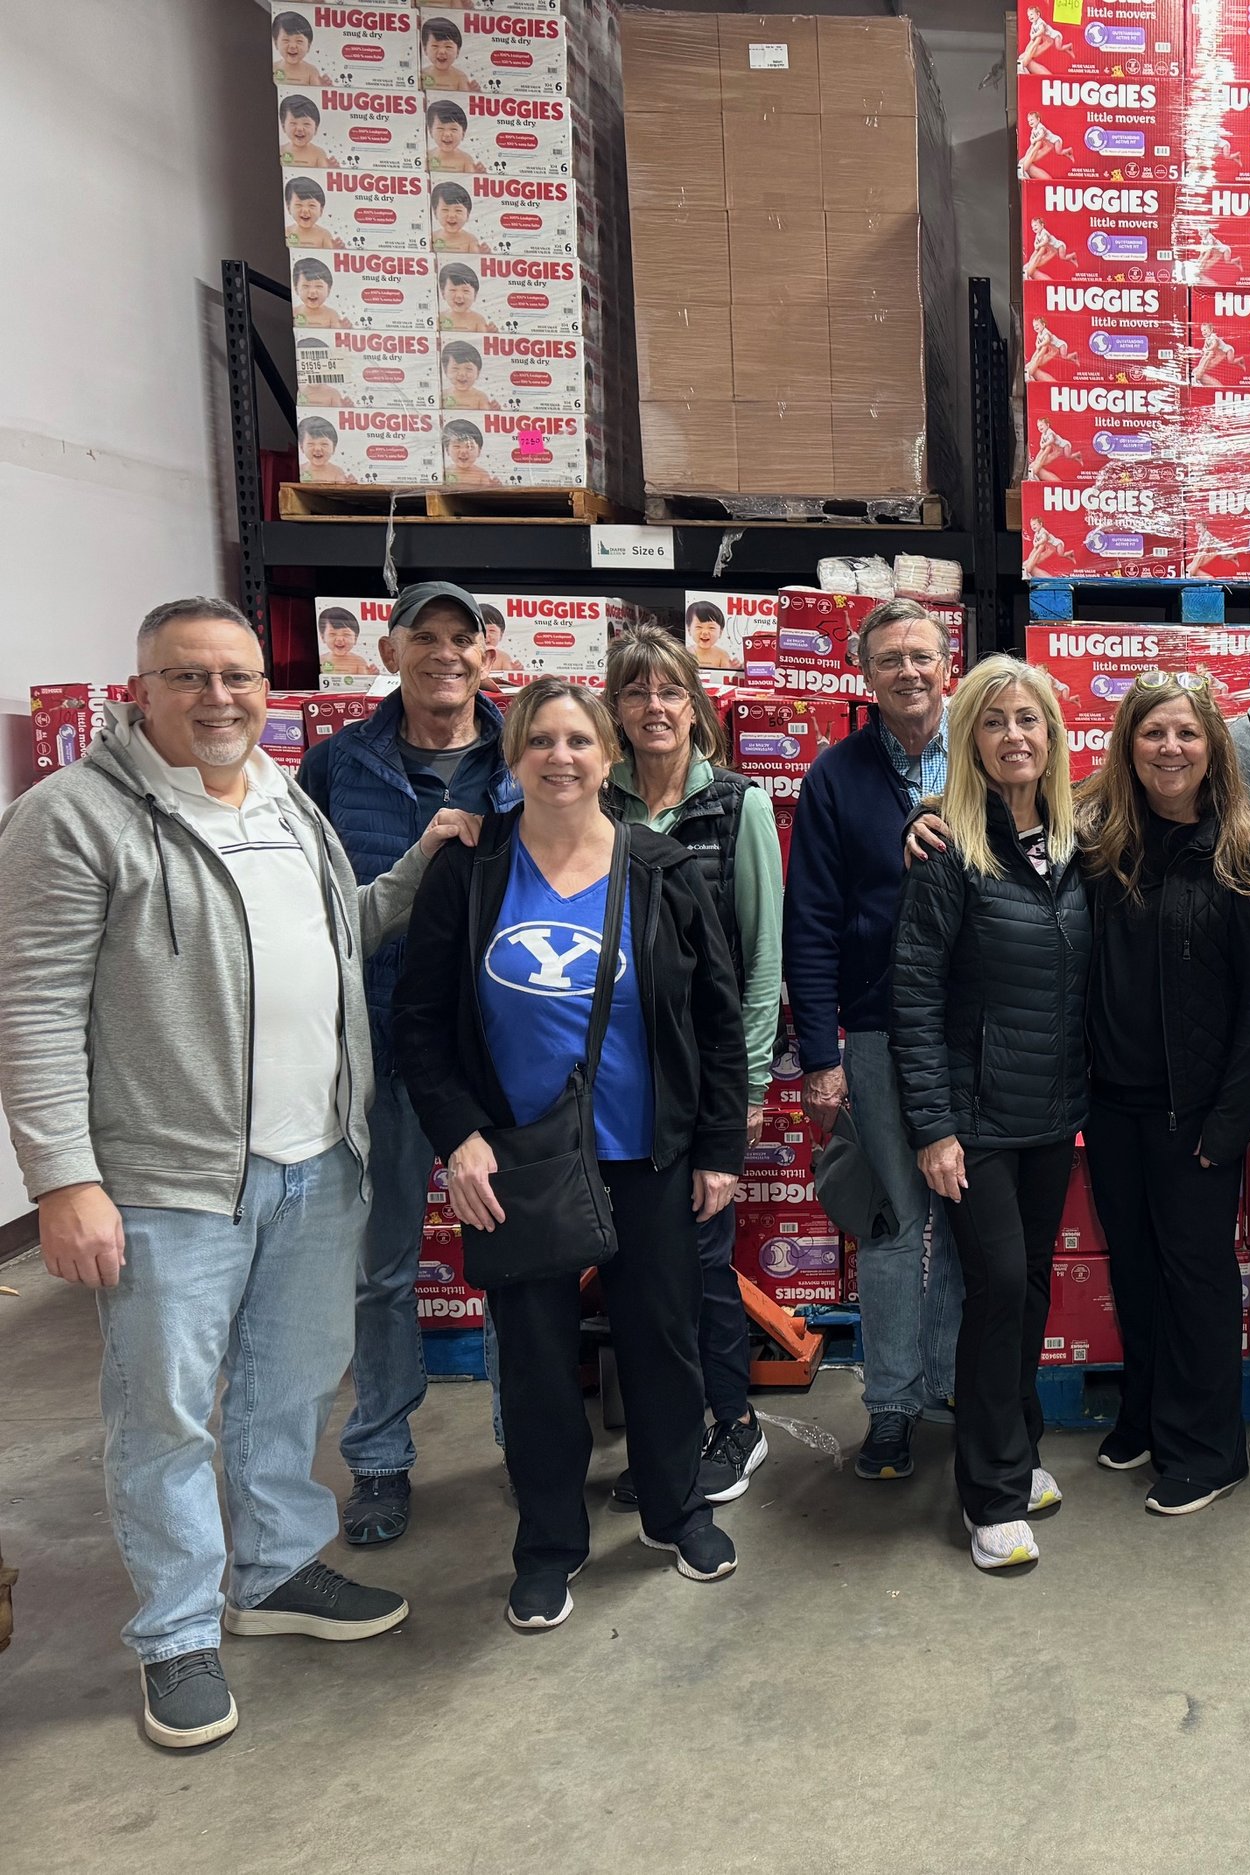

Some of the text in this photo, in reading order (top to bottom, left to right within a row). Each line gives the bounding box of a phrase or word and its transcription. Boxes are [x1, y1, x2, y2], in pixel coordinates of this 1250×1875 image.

[314, 7, 411, 32] HUGGIES
[1087, 6, 1157, 20] little movers
[464, 13, 559, 39] HUGGIES
[1170, 62, 1180, 76] 5
[408, 75, 415, 85] 6
[321, 90, 417, 114] HUGGIES
[1042, 80, 1156, 109] HUGGIES
[469, 96, 563, 121] HUGGIES
[1087, 112, 1156, 125] little movers
[326, 172, 422, 195] HUGGIES
[473, 177, 568, 201] HUGGIES
[1045, 186, 1158, 213] HUGGIES
[333, 252, 429, 276] HUGGIES
[480, 258, 574, 281] HUGGIES
[1046, 286, 1159, 314] HUGGIES
[427, 317, 434, 327] 6
[335, 332, 429, 354] HUGGIES
[483, 336, 577, 359] HUGGIES
[1051, 387, 1164, 414] HUGGIES
[339, 411, 432, 432] HUGGIES
[484, 414, 578, 435] HUGGIES
[431, 472, 438, 482] 6
[1044, 487, 1154, 512] HUGGIES
[632, 545, 665, 556] Size 6
[507, 599, 600, 620] HUGGIES
[534, 619, 550, 627] snug
[561, 619, 573, 627] dry
[1049, 634, 1159, 658] HUGGIES
[598, 658, 604, 668] 6
[779, 655, 840, 669] little movers
[952, 664, 960, 674] 6
[1093, 661, 1158, 672] little movers
[785, 762, 811, 773] ittle
[743, 1169, 777, 1177] mover
[734, 1182, 816, 1203] UGGIES
[776, 1287, 835, 1300] HUGGIES
